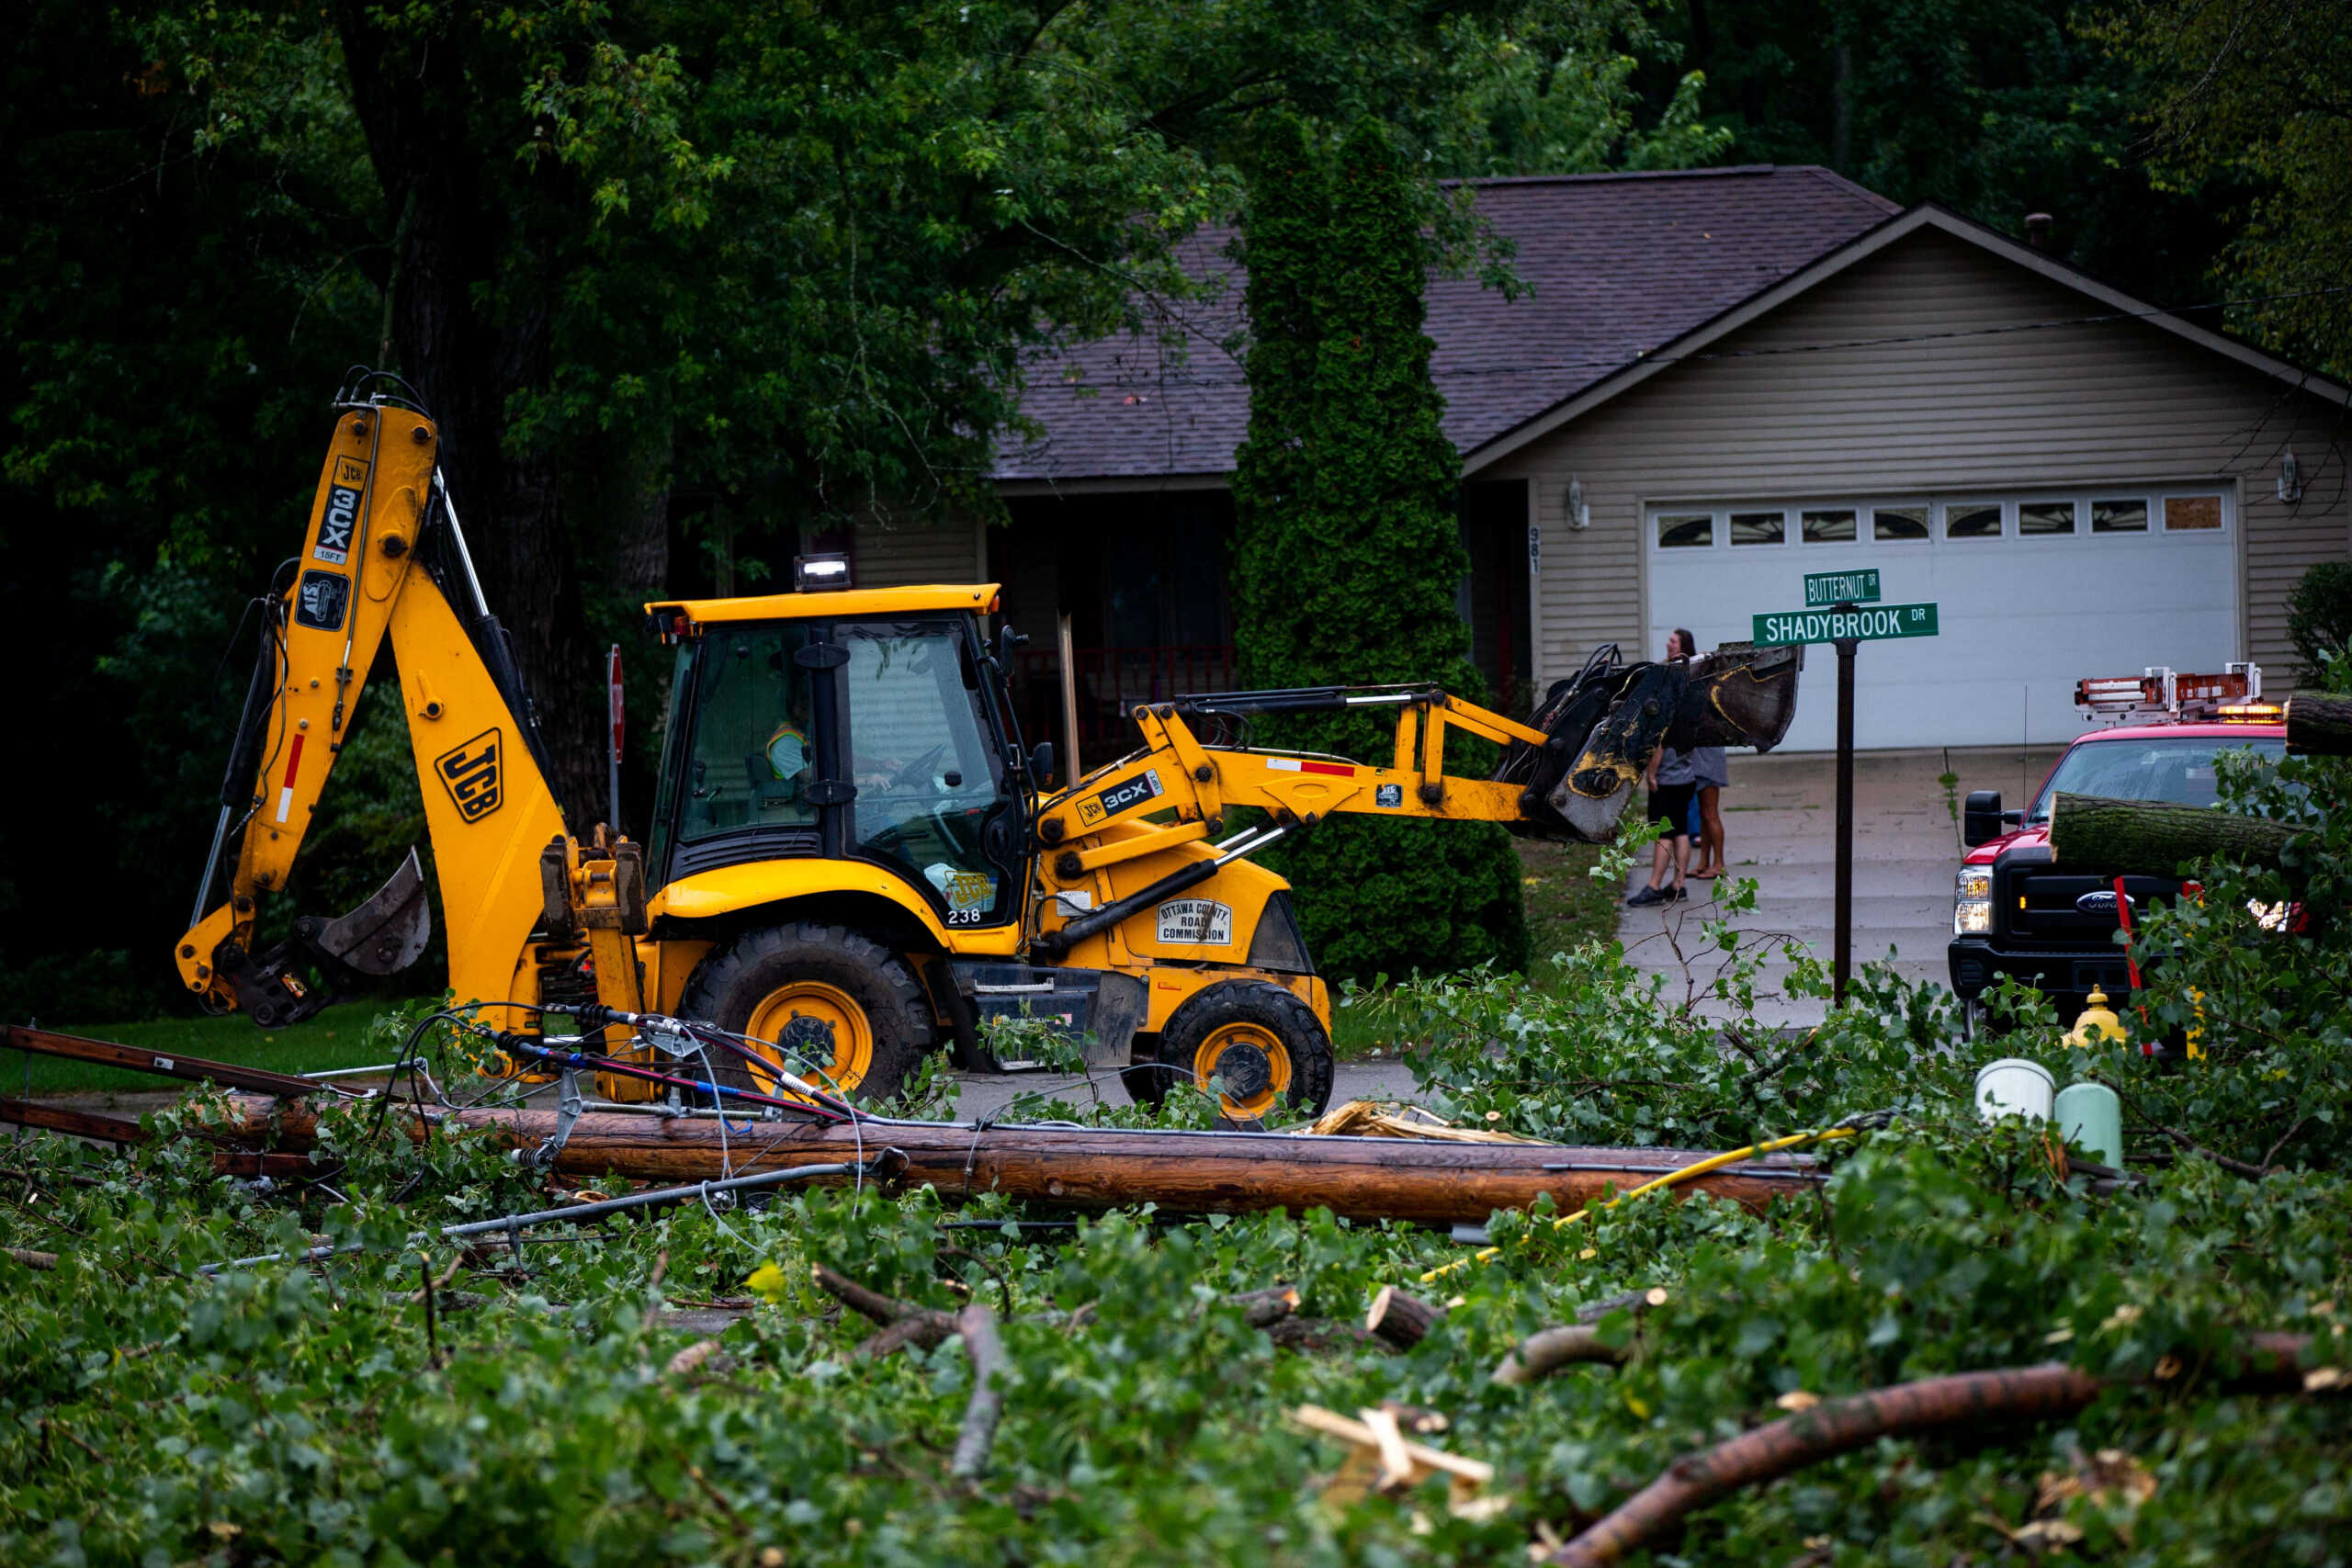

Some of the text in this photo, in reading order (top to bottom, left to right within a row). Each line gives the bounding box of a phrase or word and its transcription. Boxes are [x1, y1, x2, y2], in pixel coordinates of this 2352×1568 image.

[322, 488, 356, 549] 3CX
[1808, 573, 1876, 602] BUTTERNUT DR
[1766, 608, 1926, 642] SHADYBROOK DR
[443, 744, 498, 816] JCB
[1103, 782, 1148, 809] 3CX
[953, 874, 989, 904] JCB
[948, 908, 980, 924] 238
[1160, 903, 1193, 919] OTTAWA
[1181, 917, 1207, 927] ROAD
[1163, 928, 1225, 940] COMMISION
